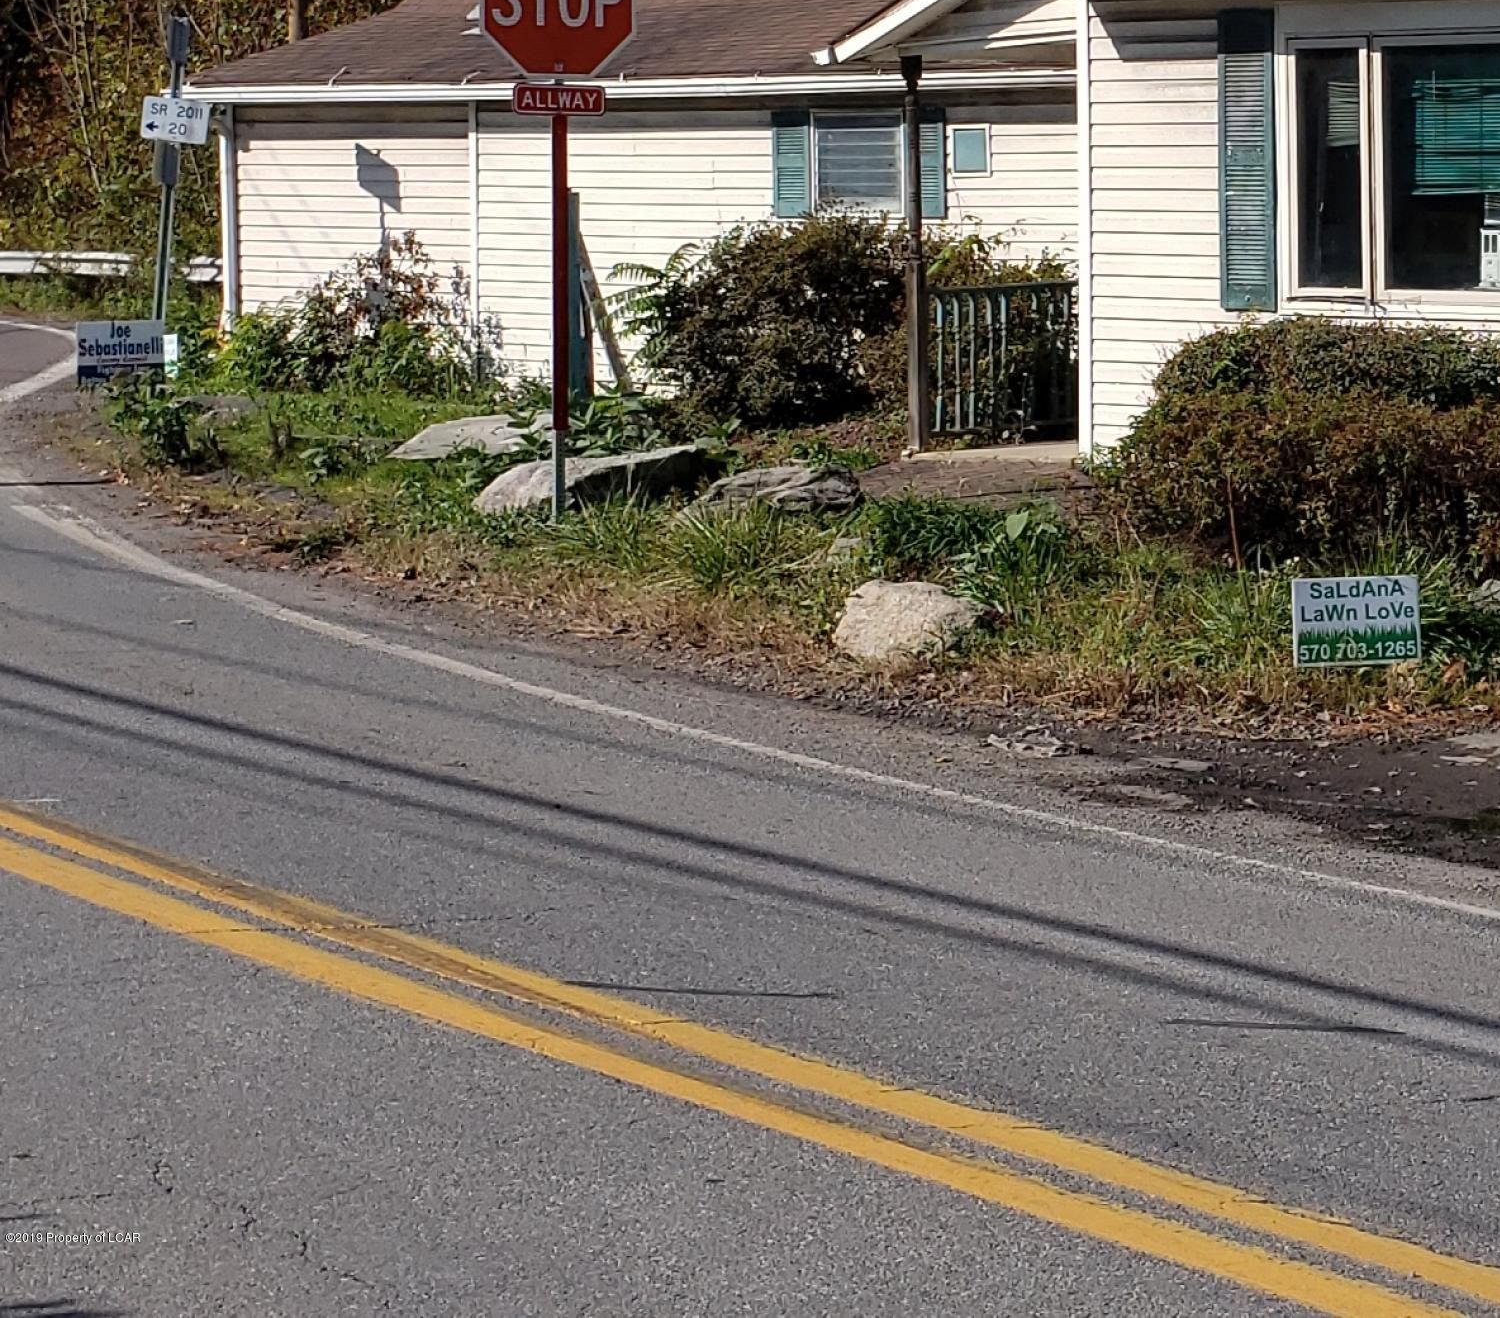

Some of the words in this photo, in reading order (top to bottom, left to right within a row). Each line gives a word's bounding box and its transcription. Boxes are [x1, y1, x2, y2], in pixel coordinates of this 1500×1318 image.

[151, 103, 168, 116] SR
[176, 105, 203, 120] 2011
[168, 122, 187, 136] 20
[110, 321, 132, 339] Joe
[79, 336, 163, 357] Sebastianelli
[1301, 603, 1357, 622] LaWn
[1365, 601, 1415, 620] LoVe
[1300, 644, 1330, 661] 570
[1336, 640, 1416, 659] 703-1265
